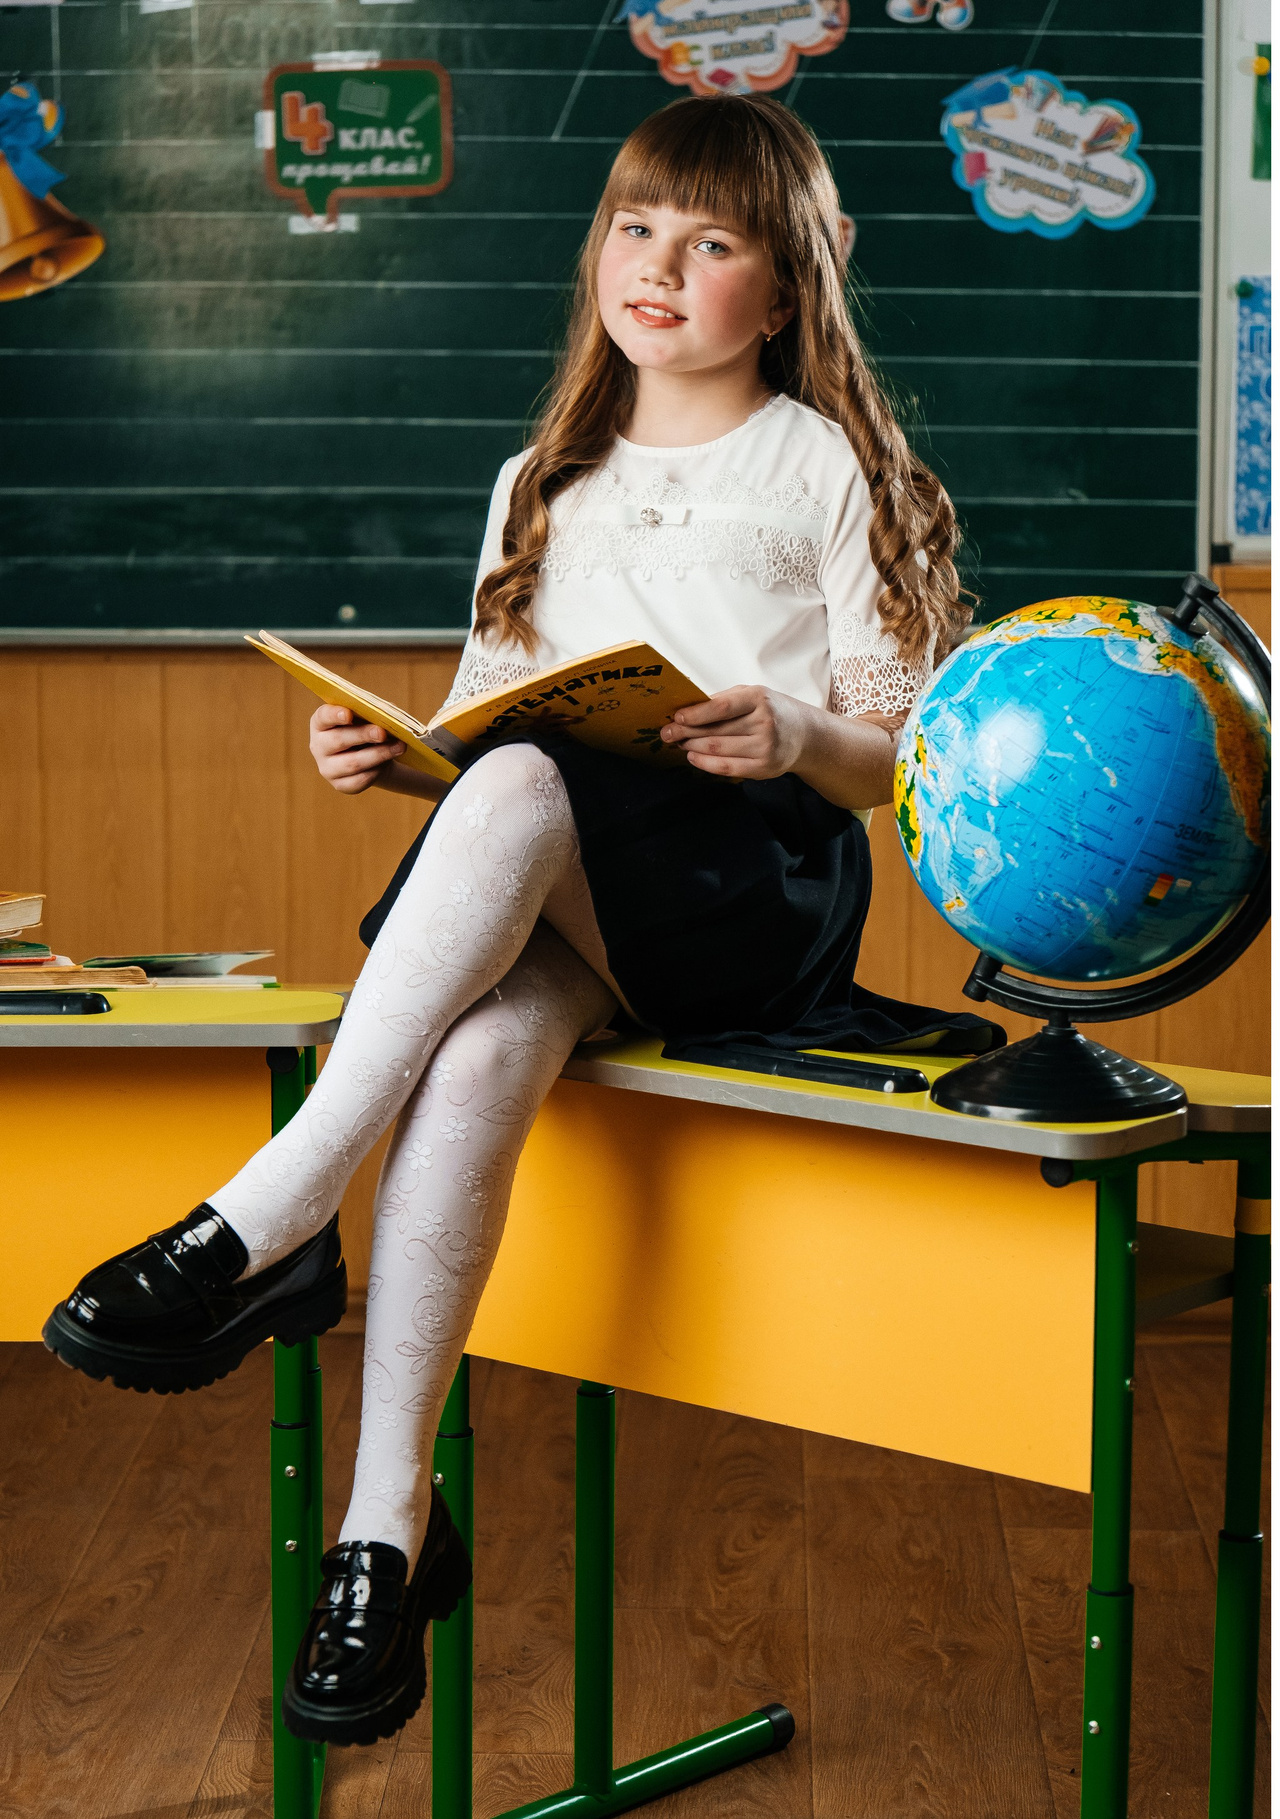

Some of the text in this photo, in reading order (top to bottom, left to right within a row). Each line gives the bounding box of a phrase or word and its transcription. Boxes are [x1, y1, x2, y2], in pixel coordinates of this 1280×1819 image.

[282, 91, 334, 154] 4
[281, 153, 431, 185] прощавай!
[562, 695, 580, 706] 1
